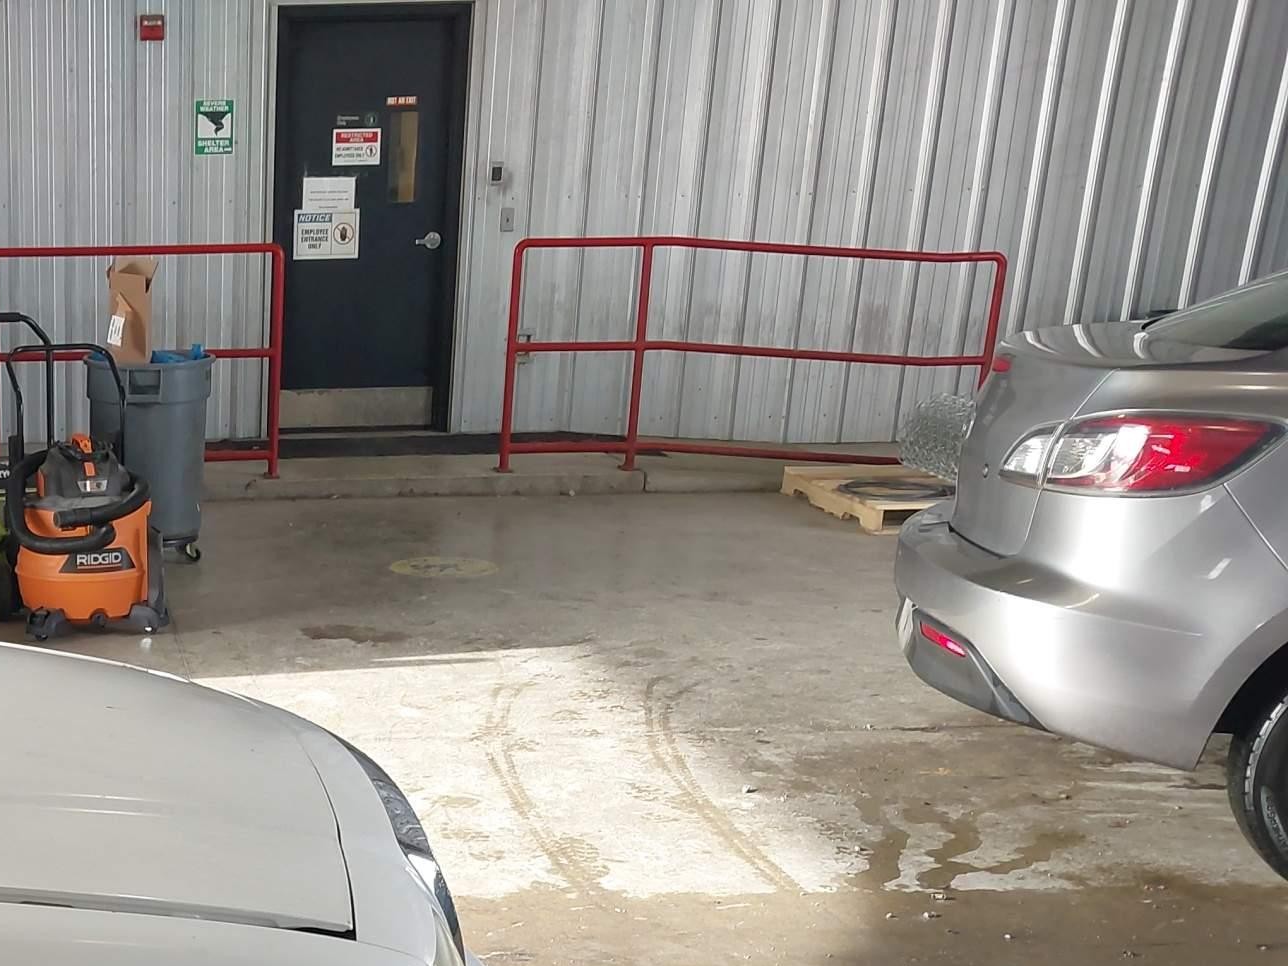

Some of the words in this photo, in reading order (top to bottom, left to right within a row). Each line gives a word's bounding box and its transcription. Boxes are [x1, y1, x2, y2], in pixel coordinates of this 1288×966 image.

[299, 214, 331, 222] NOTICE
[301, 228, 329, 236] EMPLOYEE
[76, 552, 122, 565] RIDGID
